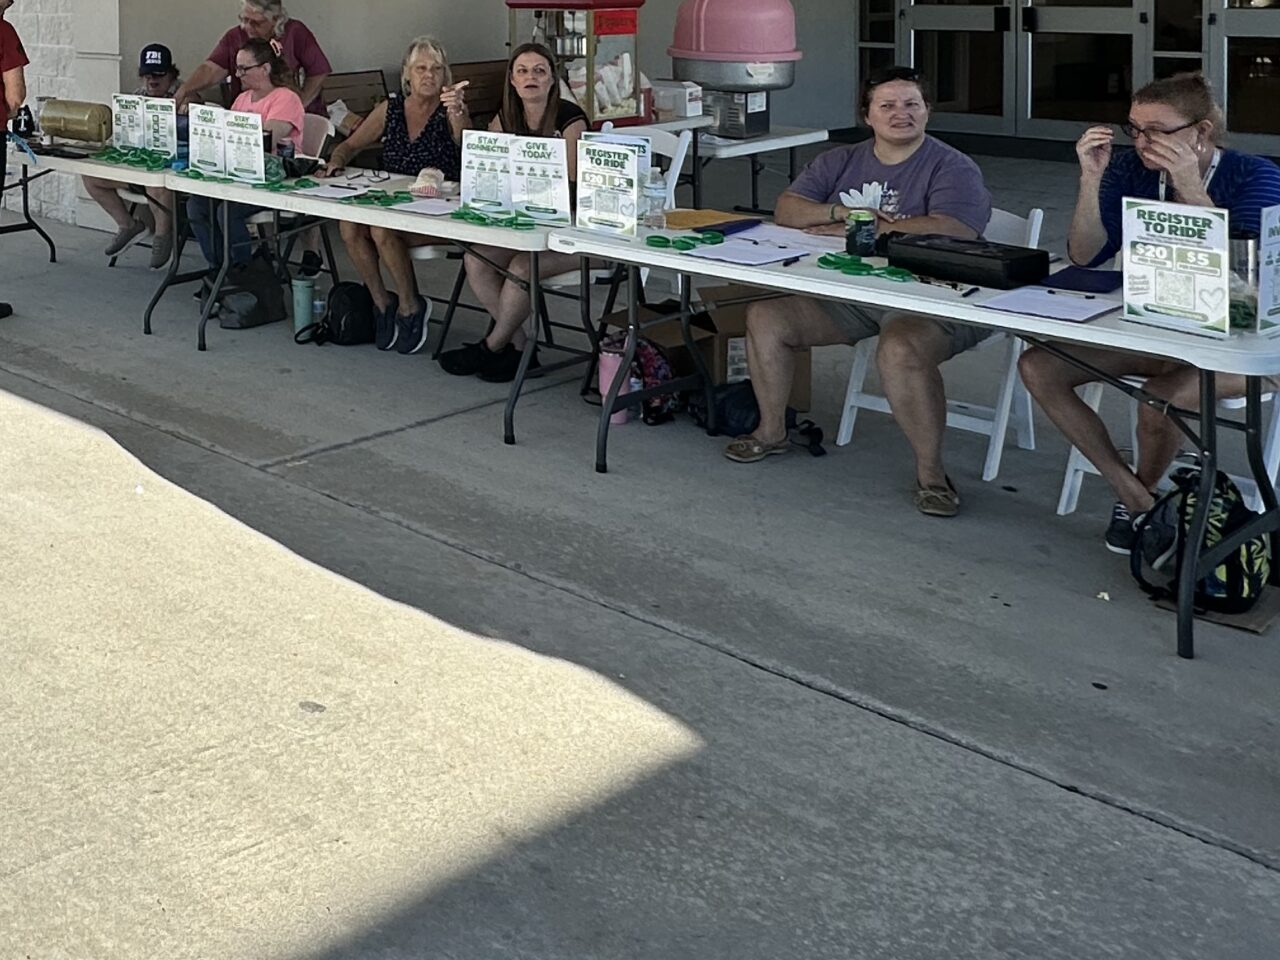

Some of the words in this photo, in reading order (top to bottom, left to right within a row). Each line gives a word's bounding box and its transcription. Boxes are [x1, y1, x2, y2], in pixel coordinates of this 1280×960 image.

[233, 115, 250, 123] STAY
[477, 136, 499, 145] STAY
[525, 141, 548, 151] GIVE
[466, 143, 510, 154] CONNECTED
[521, 150, 553, 159] TODAY
[585, 147, 630, 161] REGISTER
[589, 156, 602, 166] TO
[603, 159, 626, 169] RIDE
[584, 172, 604, 185] $20
[1136, 209, 1213, 229] REGISTER
[1142, 221, 1165, 233] TO
[1167, 225, 1207, 240] RIDE
[1135, 243, 1167, 259] $20
[1186, 251, 1210, 266] $5
